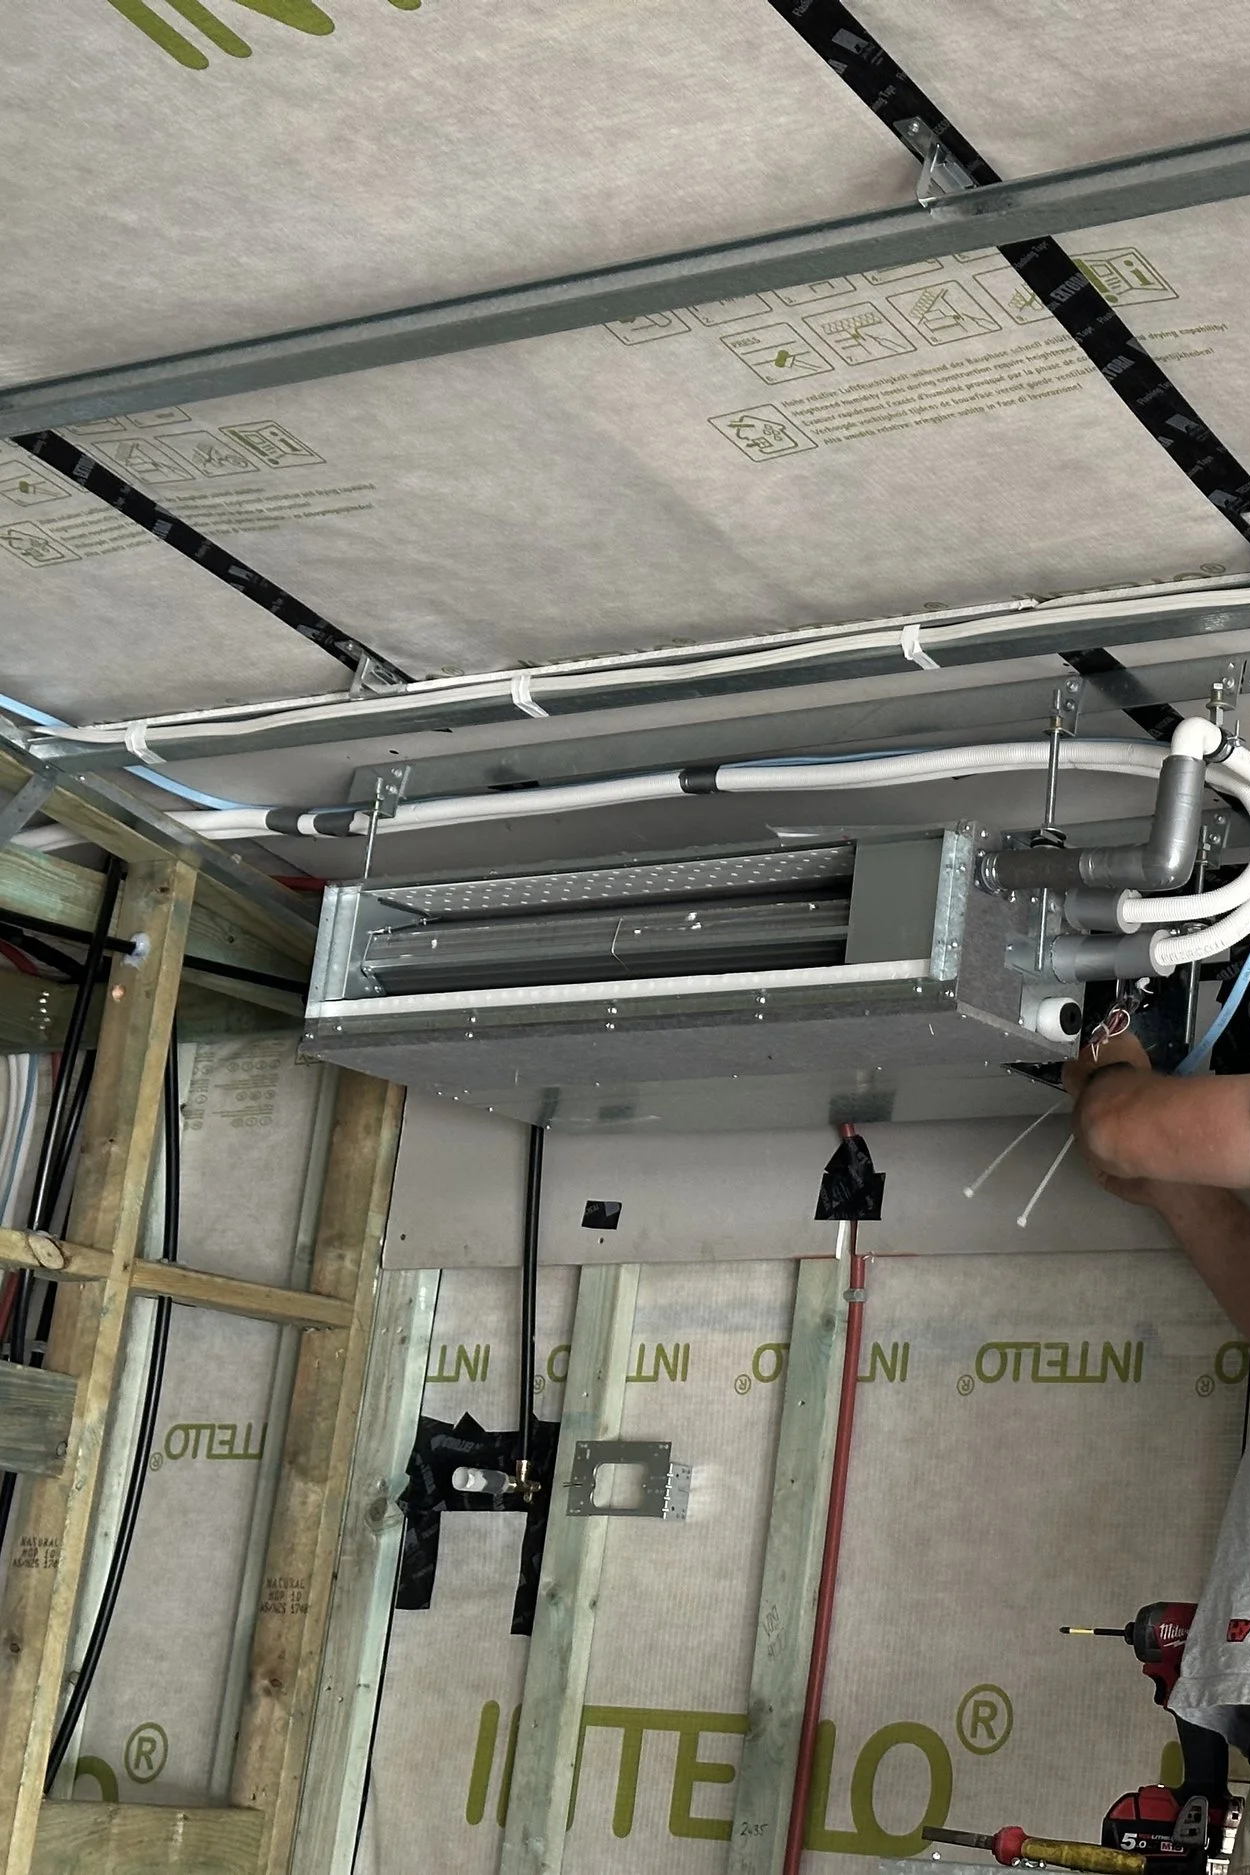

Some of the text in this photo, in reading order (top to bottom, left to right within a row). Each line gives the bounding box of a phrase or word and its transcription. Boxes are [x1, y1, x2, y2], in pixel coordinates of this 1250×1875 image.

[730, 336, 760, 348] PRESS
[1044, 334, 1074, 346] ablüft
[20, 1536, 60, 1547] NATURAL
[266, 1577, 305, 1589] NATURAL
